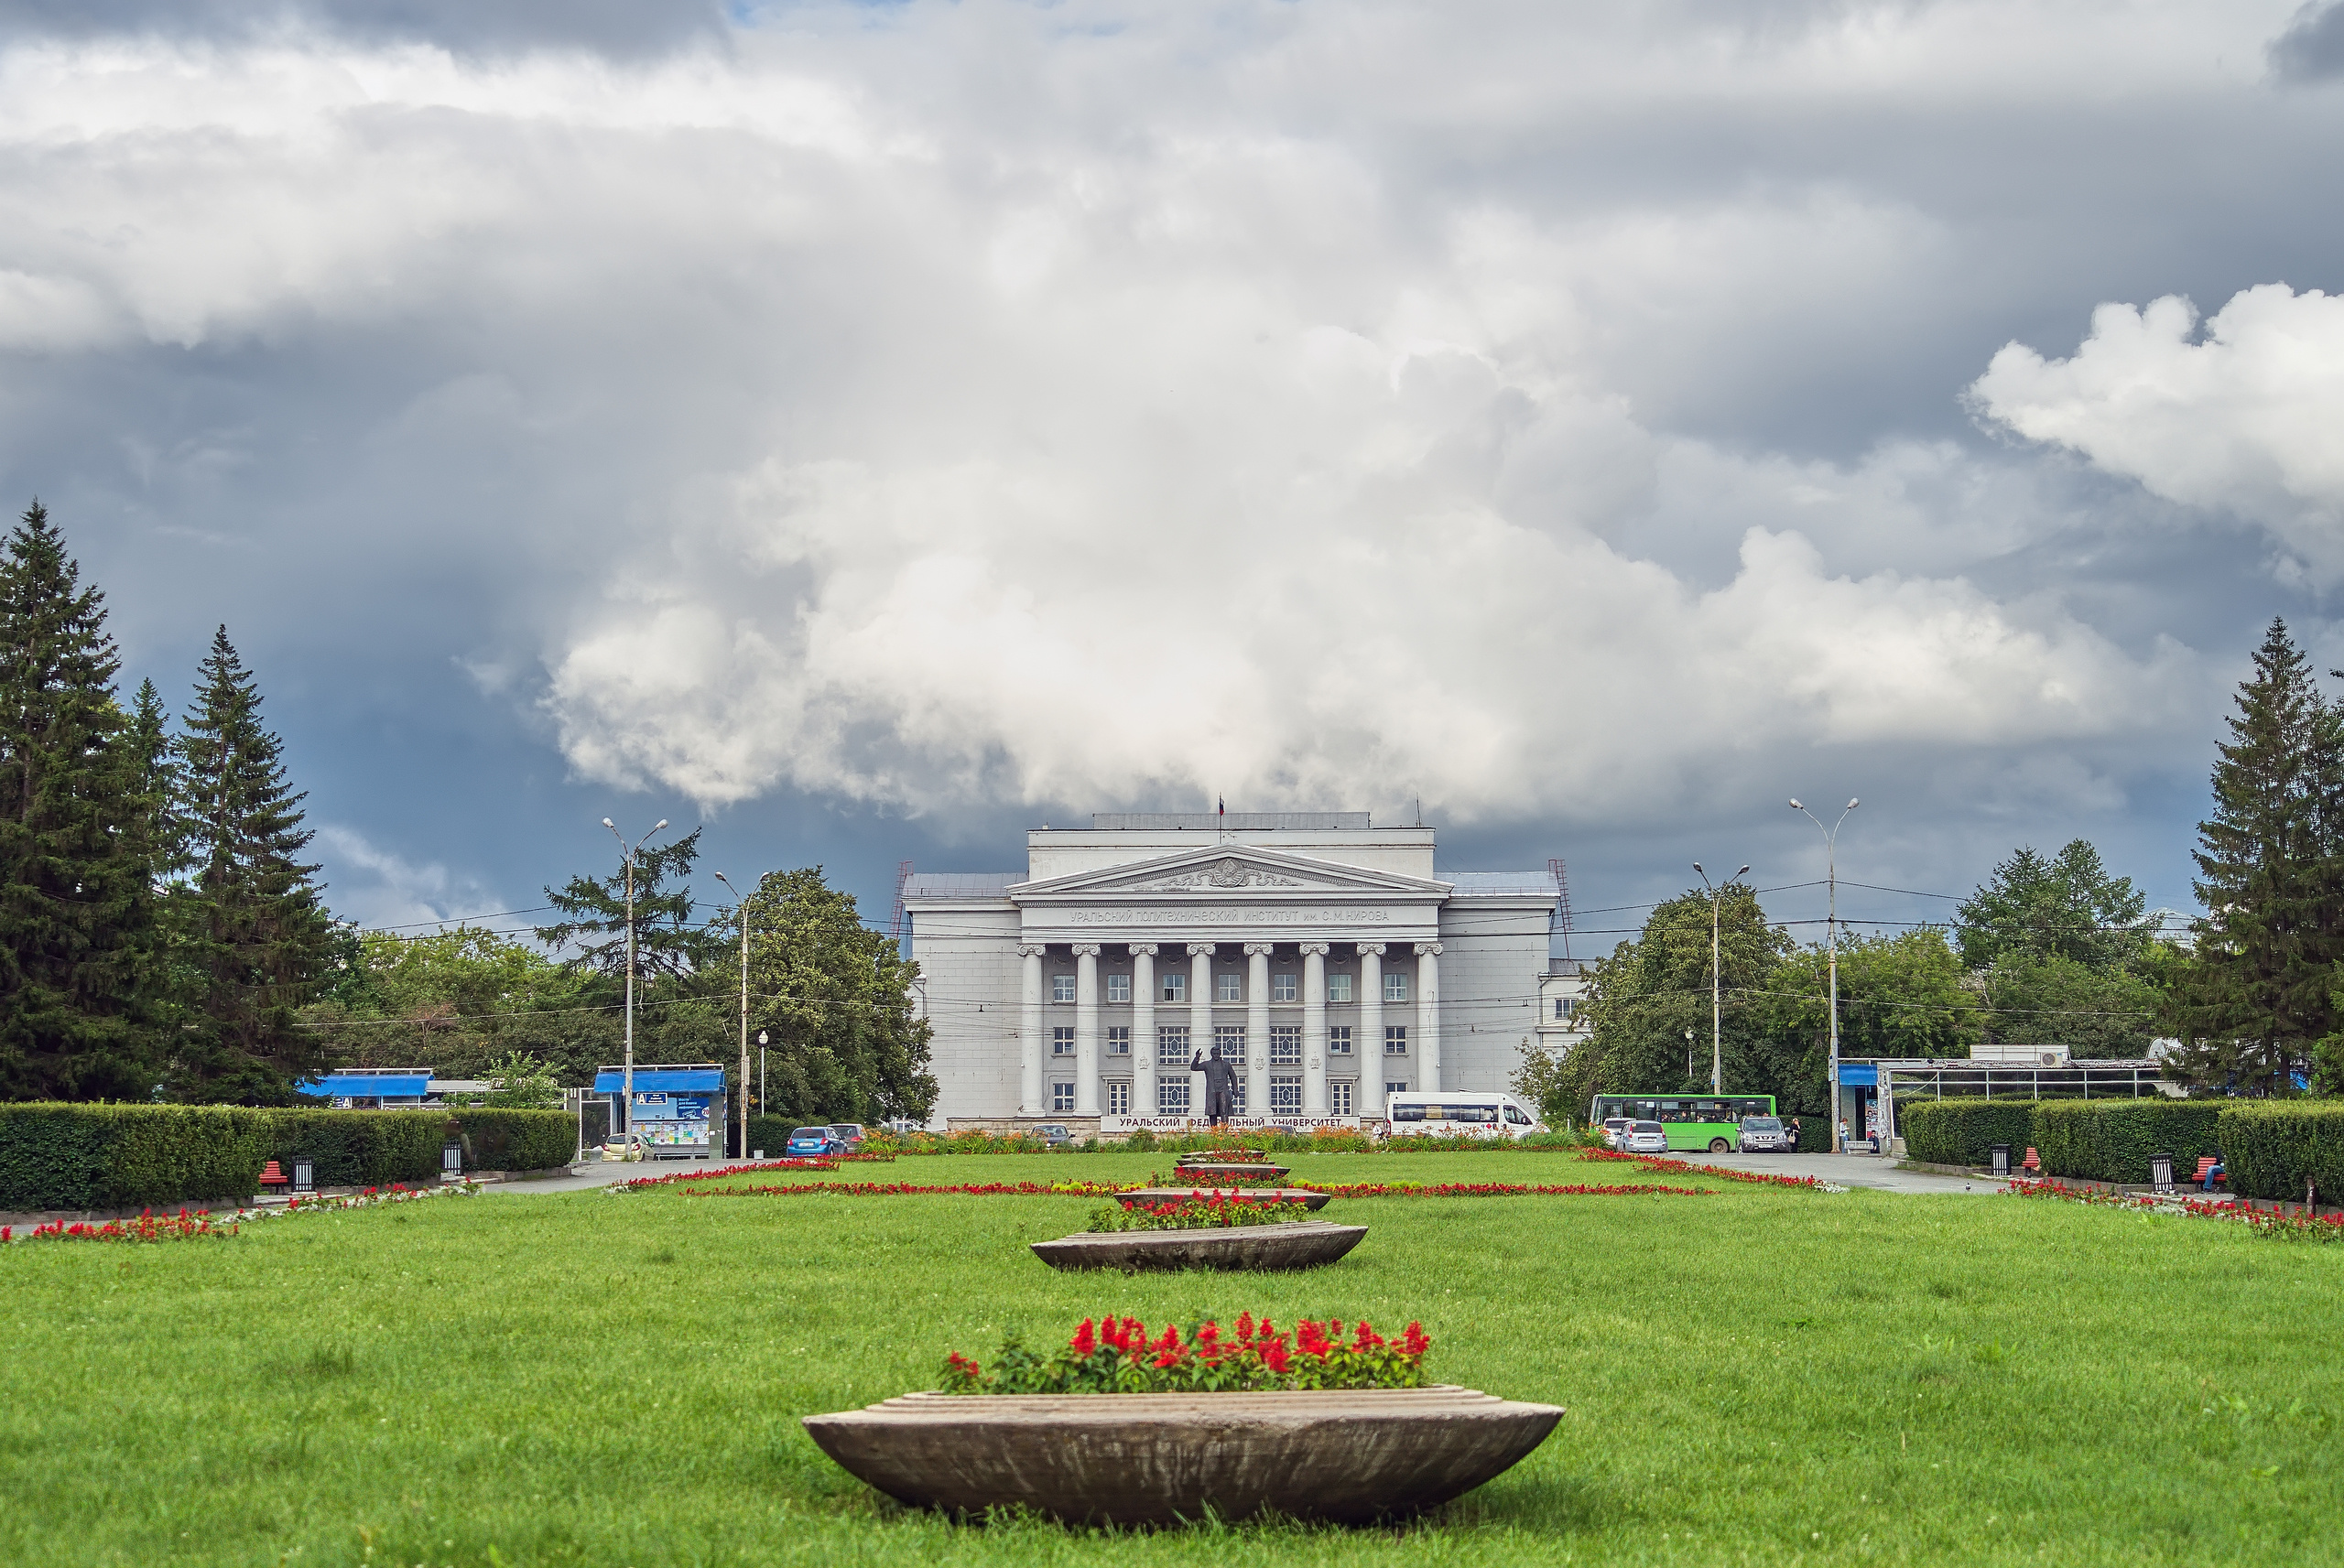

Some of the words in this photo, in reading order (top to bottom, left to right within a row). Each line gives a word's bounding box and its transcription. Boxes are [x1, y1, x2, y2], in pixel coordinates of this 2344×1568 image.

[1070, 909, 1132, 923] УРАЛЬСКИЙ
[1135, 909, 1238, 922] ПОЛИТЕХНИЧЕСКИЙ
[1243, 911, 1298, 922] ИНСТИТУТ
[1119, 1117, 1180, 1127] УРАЛЬСКИЙ
[1188, 1117, 1265, 1128] ФЕДЛЬНЫЙ
[1271, 1118, 1342, 1127] УНИВЕРСИТЕТ
